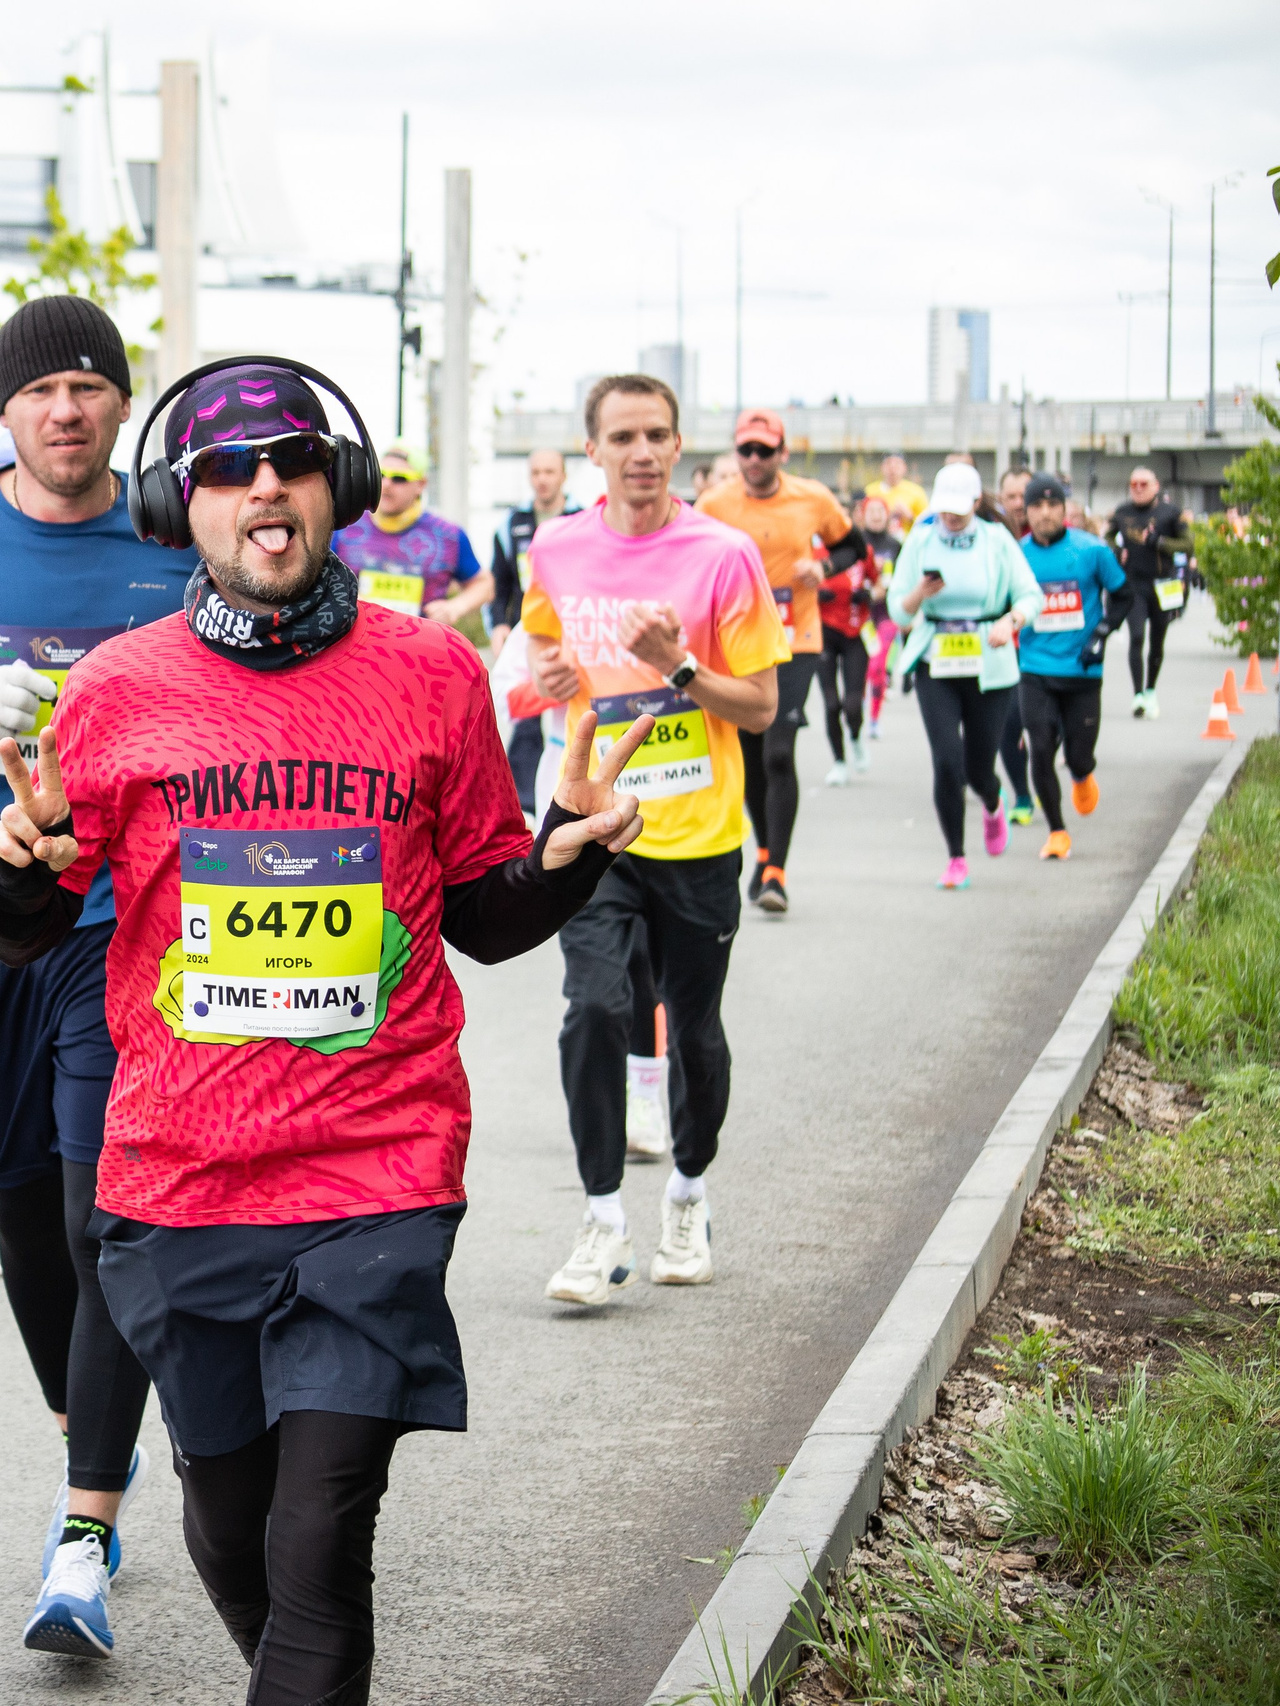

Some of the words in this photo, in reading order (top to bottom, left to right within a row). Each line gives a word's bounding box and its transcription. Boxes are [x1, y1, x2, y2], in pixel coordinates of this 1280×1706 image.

[226, 899, 352, 938] 6470
[189, 917, 207, 940] C
[186, 953, 209, 965] 2024
[265, 957, 313, 968] ИГОРЬ
[243, 1023, 271, 1032] Питание
[292, 1025, 320, 1033] финиша
